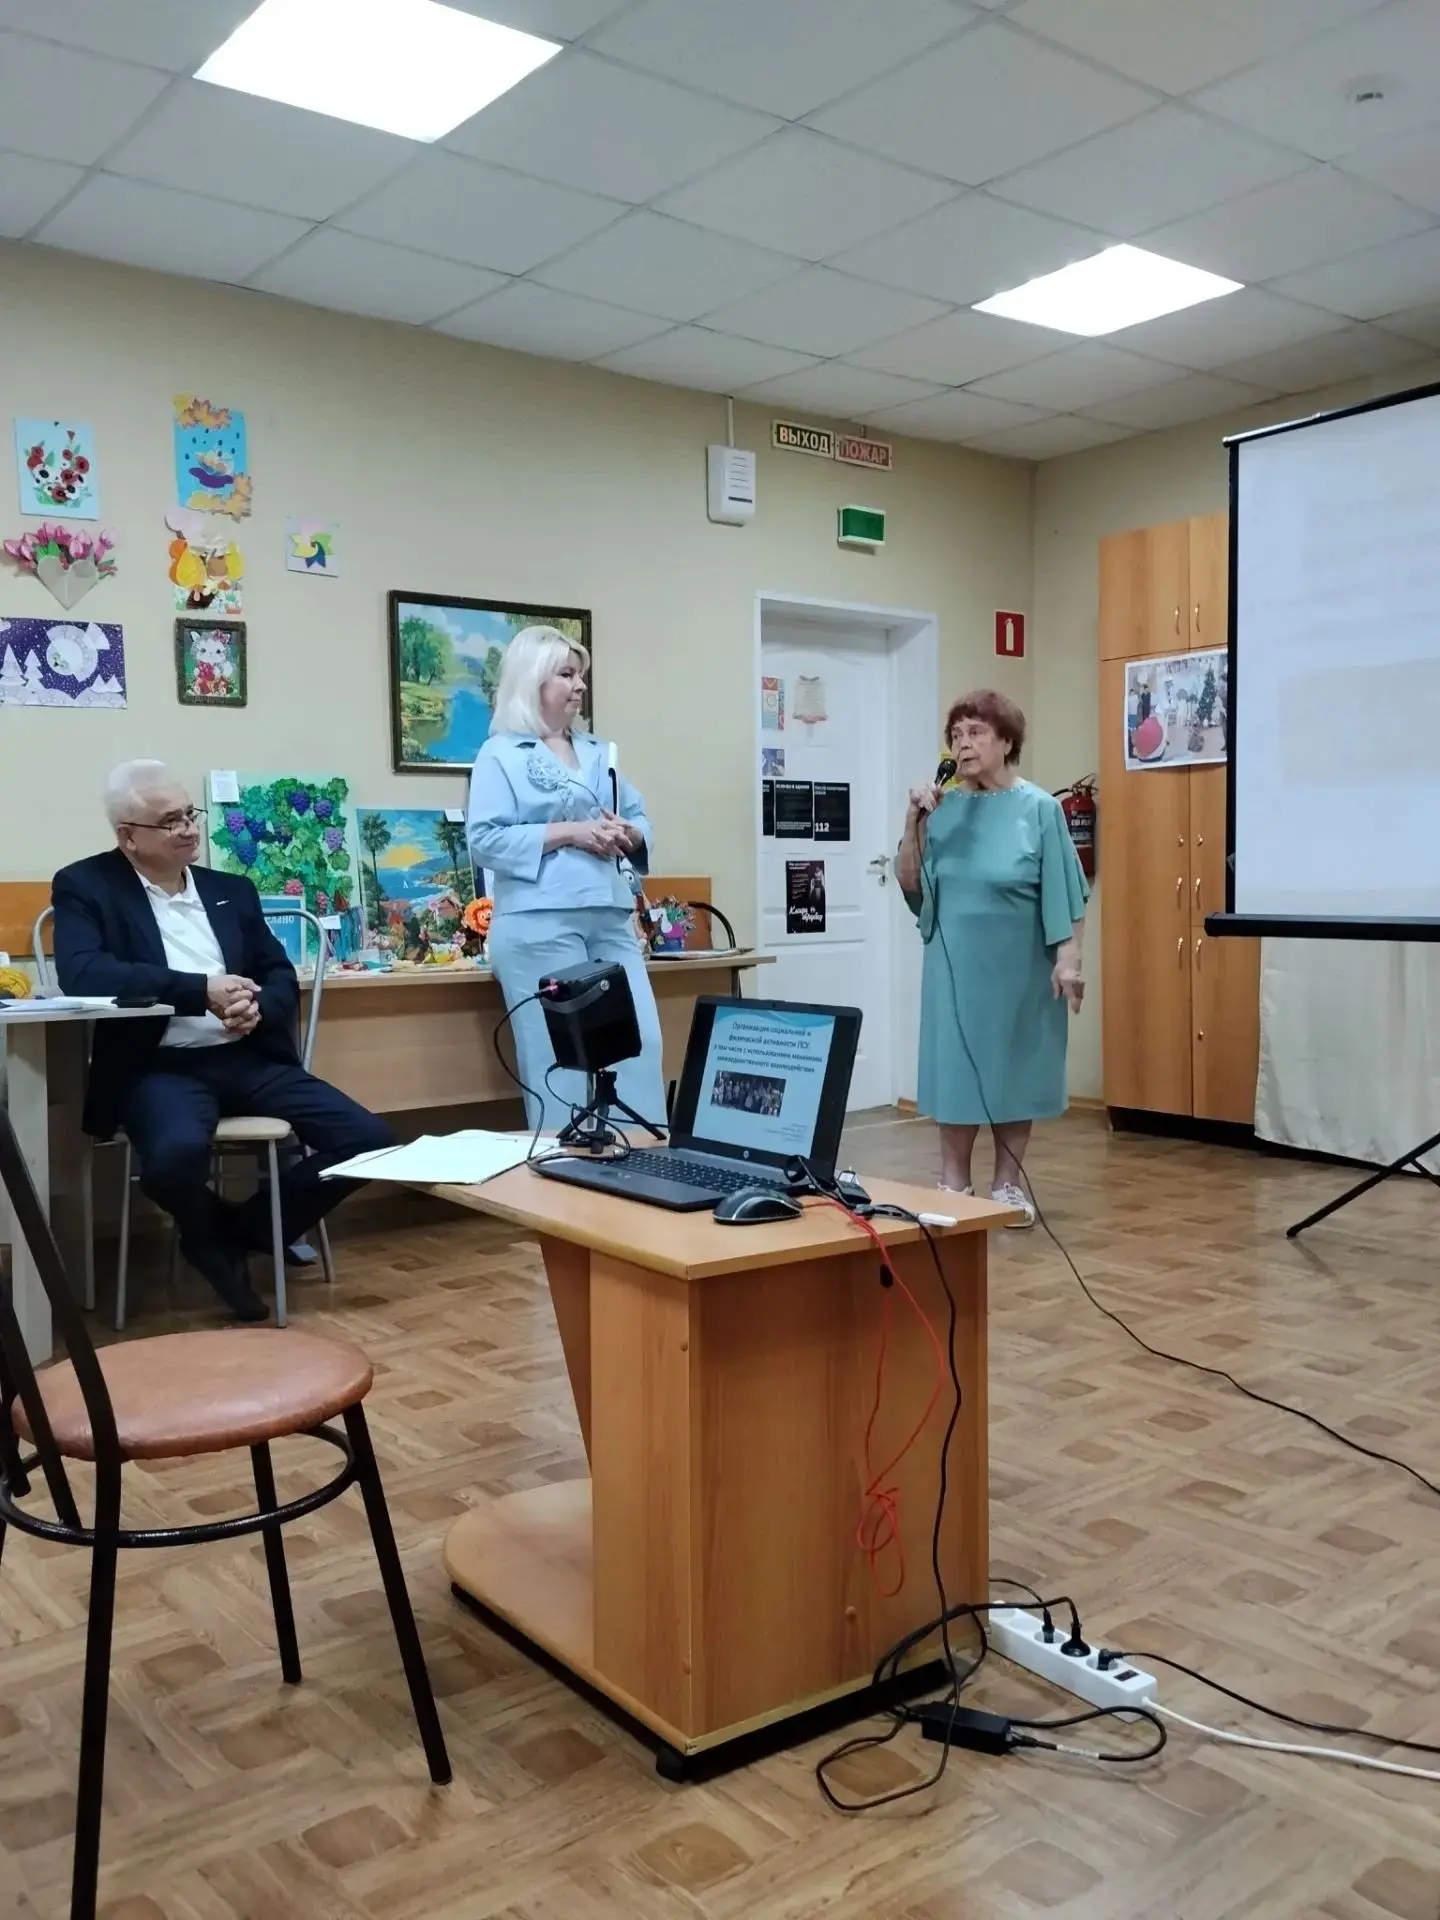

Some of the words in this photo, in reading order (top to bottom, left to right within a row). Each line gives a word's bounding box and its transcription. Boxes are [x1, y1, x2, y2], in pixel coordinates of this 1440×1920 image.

[779, 426, 829, 453] ВЫХОД
[841, 441, 887, 464] ПОЖАР
[815, 822, 830, 833] 112
